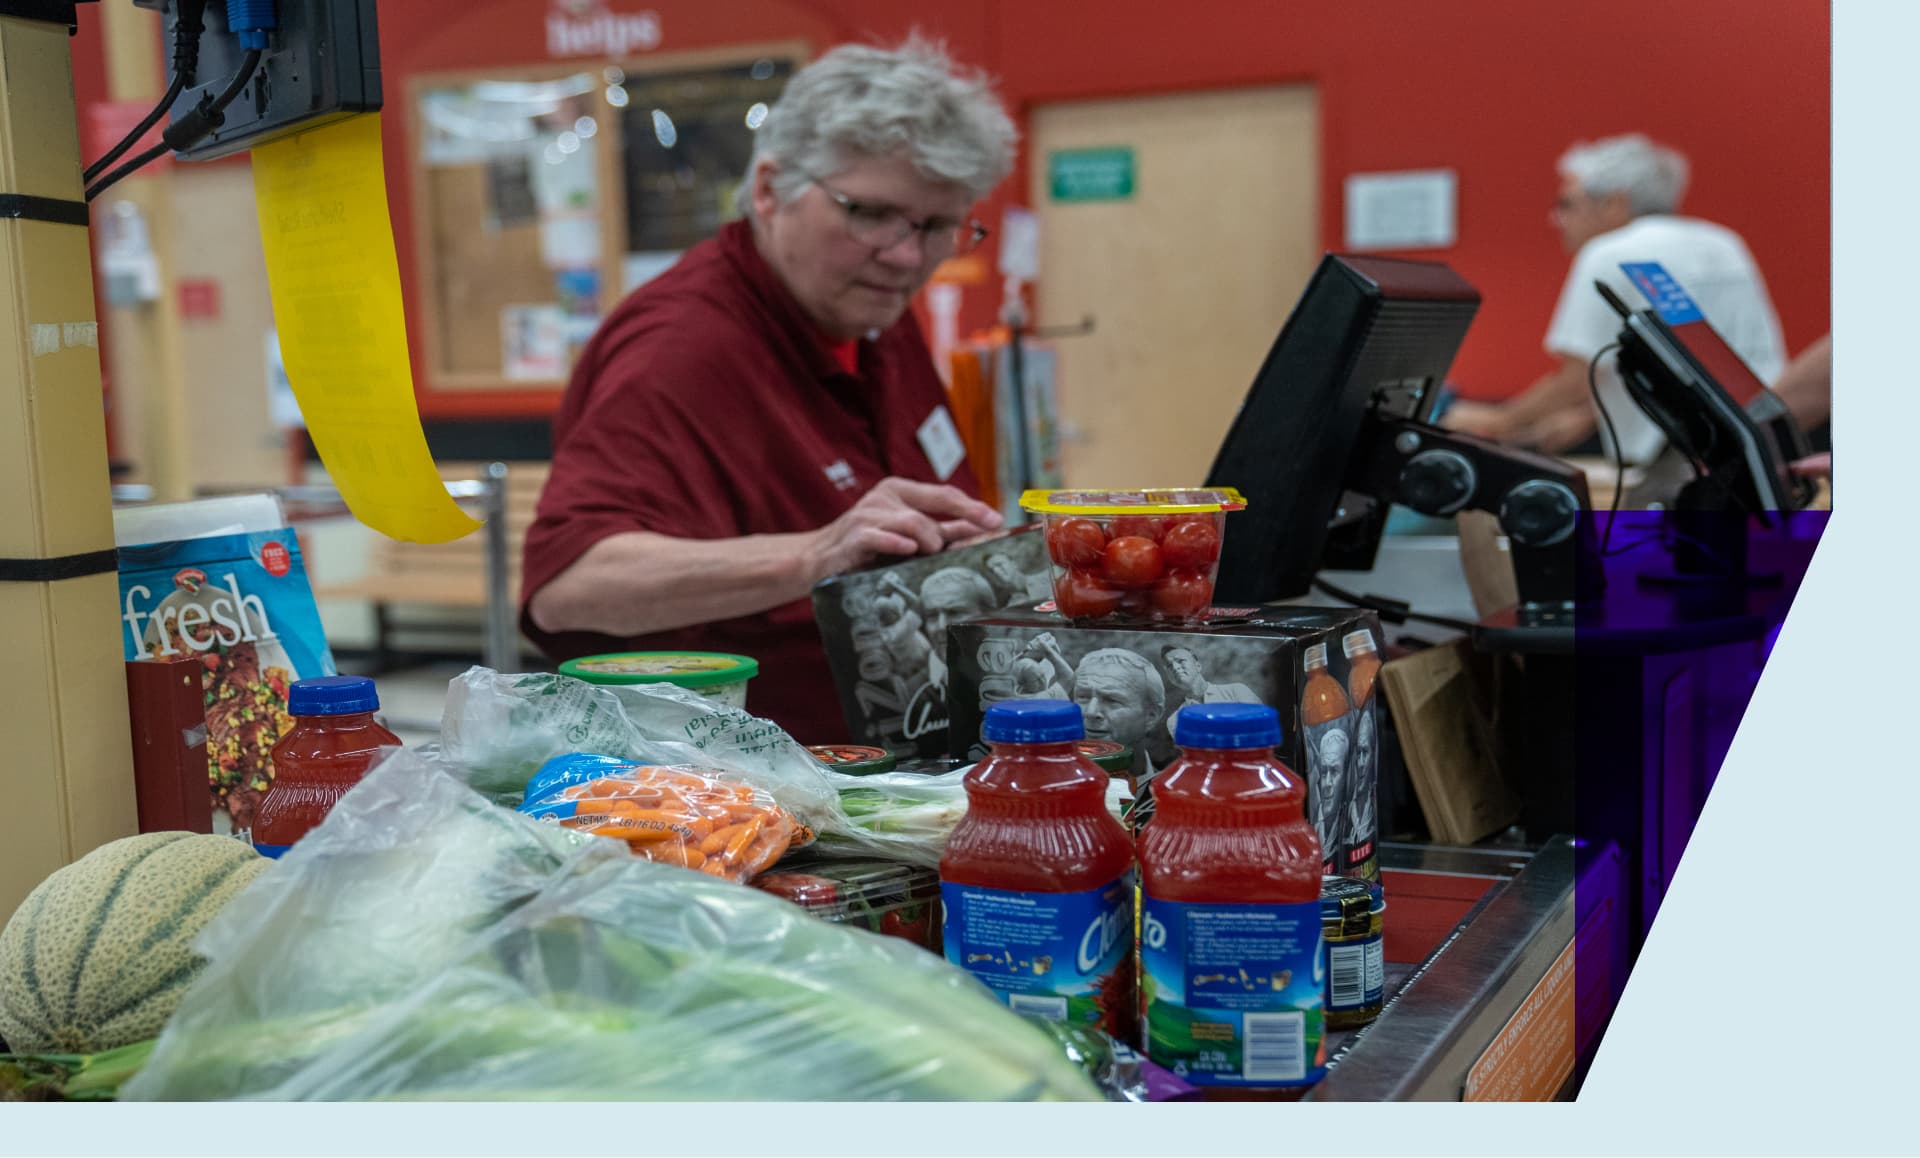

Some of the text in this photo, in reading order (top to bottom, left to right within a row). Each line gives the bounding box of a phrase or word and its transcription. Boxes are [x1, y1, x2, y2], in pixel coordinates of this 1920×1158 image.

[546, 10, 661, 58] helps
[123, 573, 279, 661] fresh
[575, 815, 594, 826] NET
[1353, 844, 1370, 862] LITE
[1478, 1037, 1509, 1083] STRICTLY
[1507, 1005, 1533, 1045] ENFORCE
